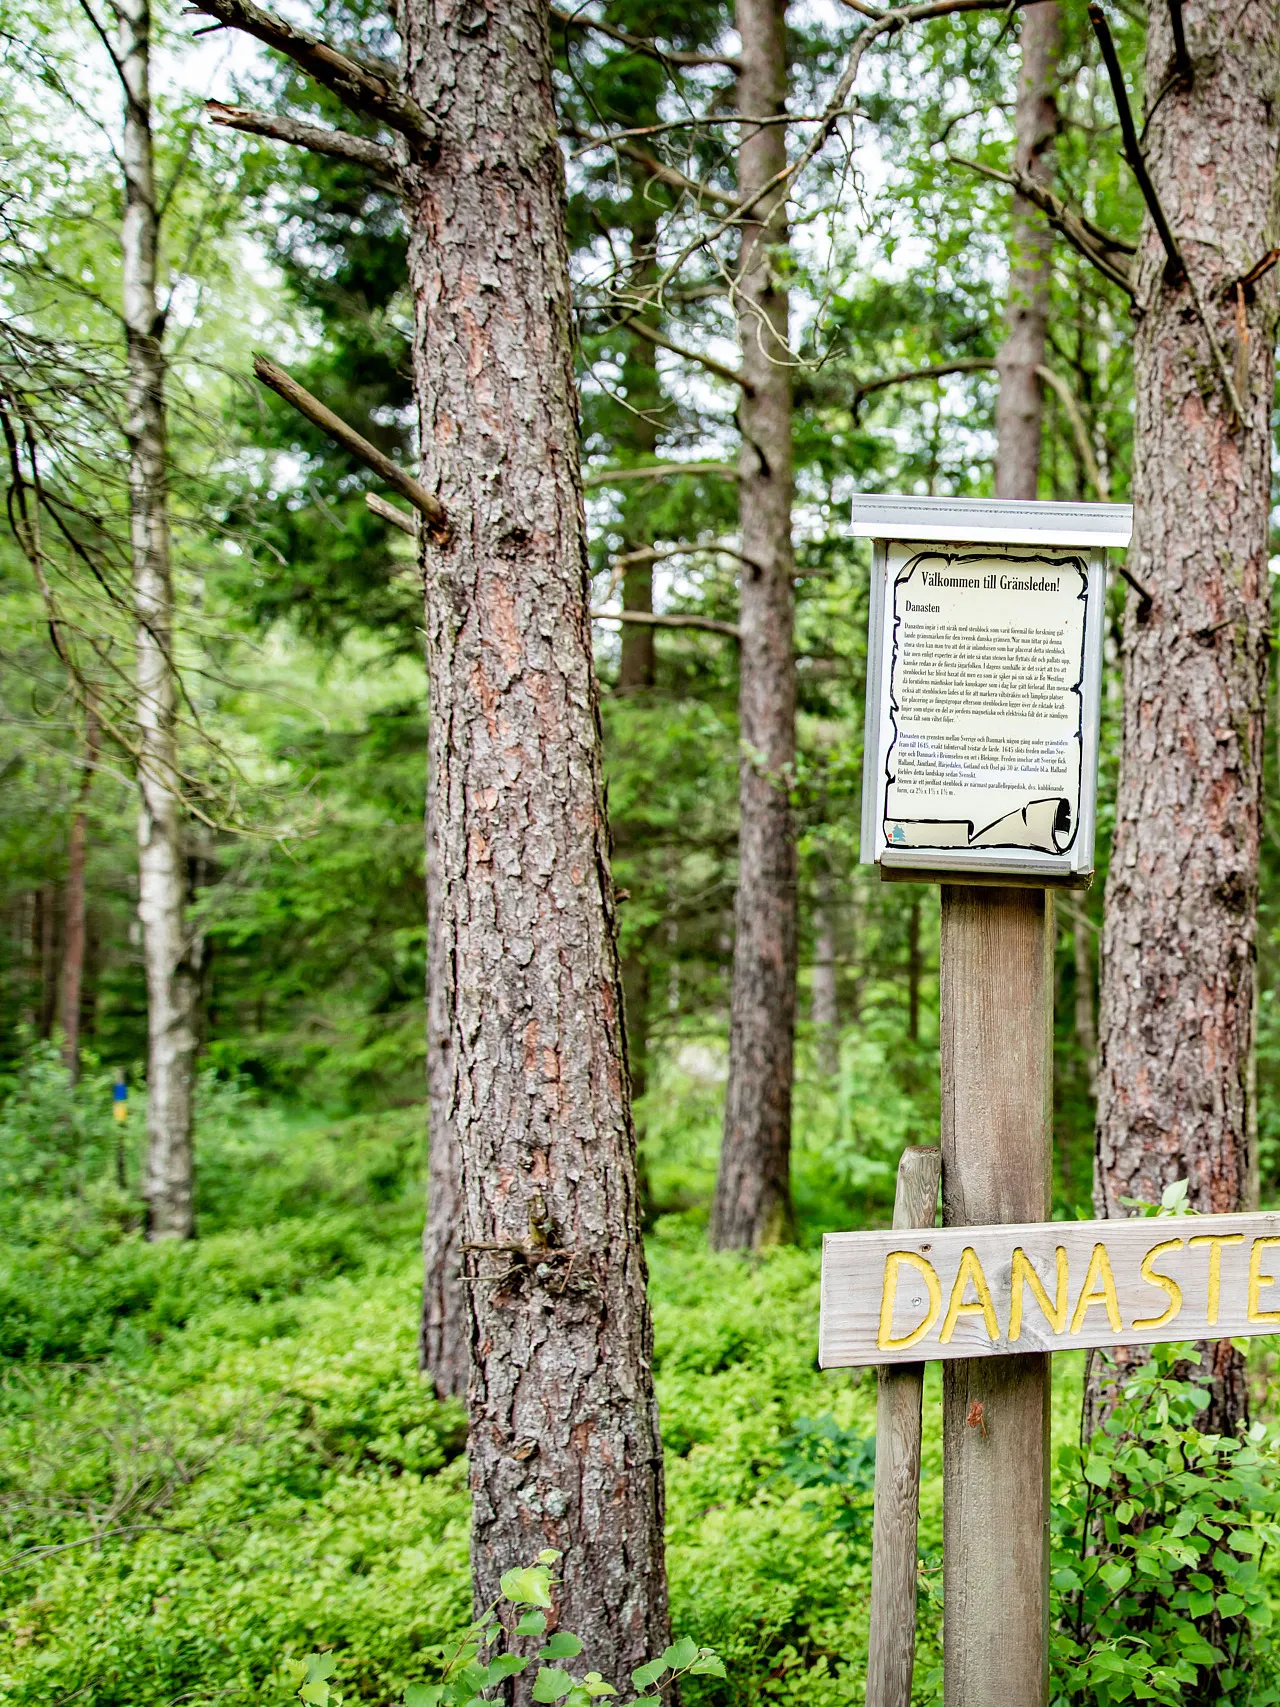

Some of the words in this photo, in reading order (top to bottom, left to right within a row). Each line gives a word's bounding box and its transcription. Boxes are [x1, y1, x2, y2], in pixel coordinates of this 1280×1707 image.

[922, 572, 980, 588] Välkommen
[984, 575, 996, 589] till
[1000, 576, 1061, 592] Gränsleden!
[905, 601, 940, 613] Danasten
